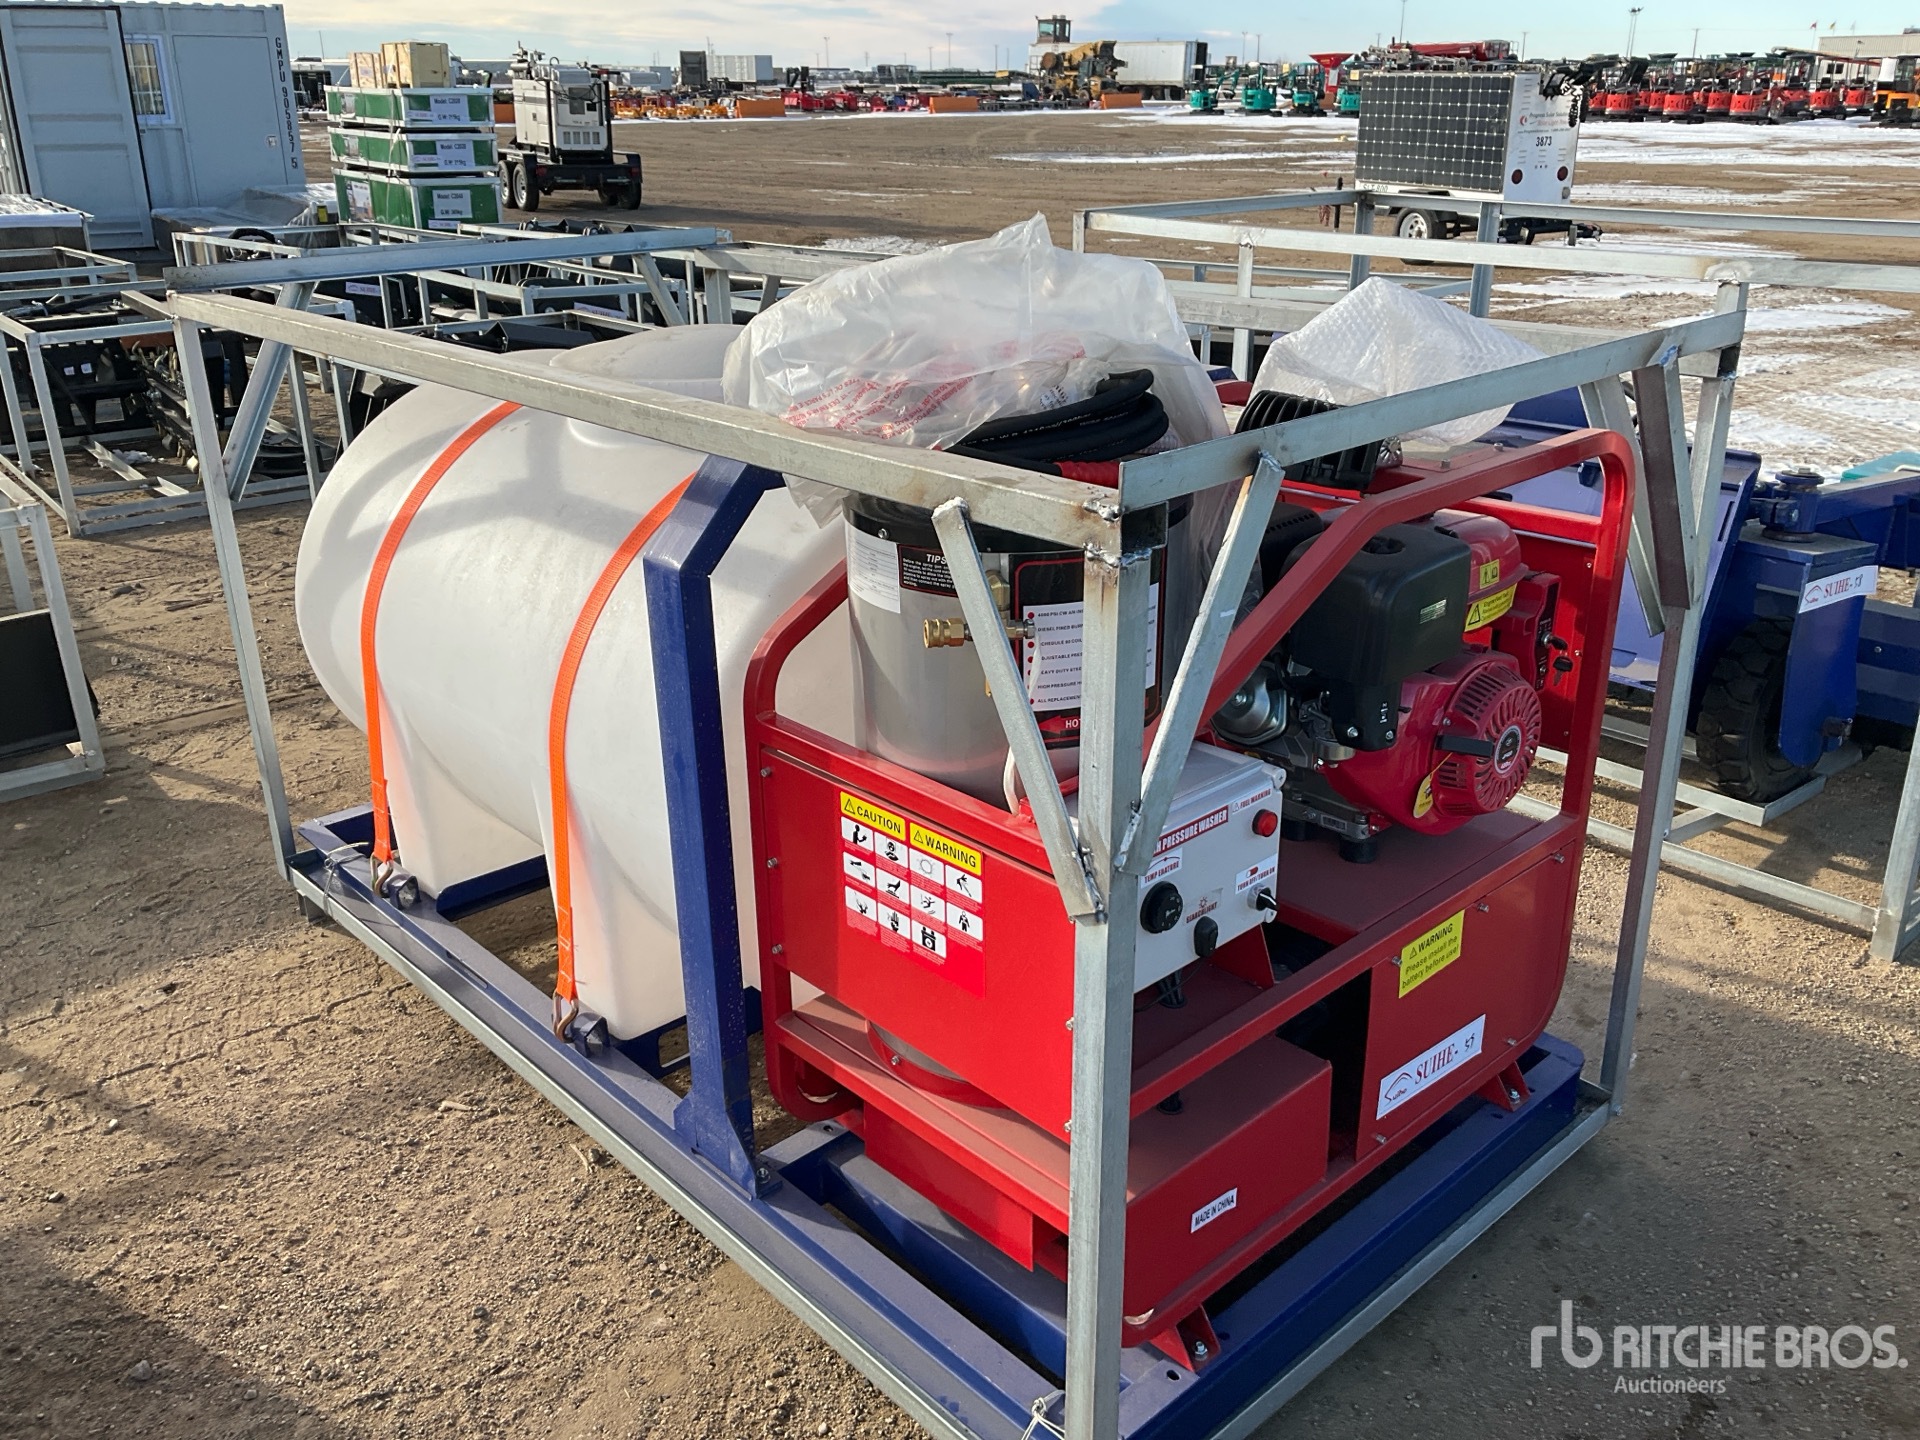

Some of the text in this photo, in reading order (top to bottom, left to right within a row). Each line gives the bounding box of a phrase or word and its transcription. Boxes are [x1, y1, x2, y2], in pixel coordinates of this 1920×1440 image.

[275, 37, 286, 82] GMPU
[282, 86, 294, 153] 905857
[1536, 136, 1552, 146] 3873
[1240, 788, 1271, 808] FUEL WARNING
[856, 807, 901, 834] CAUTION
[1162, 824, 1198, 850] PRESSURE
[1199, 810, 1227, 832] WASHER
[925, 835, 976, 867] WARNING
[1238, 881, 1248, 891] TURN
[1186, 902, 1217, 923] SEARCHLIGHT
[1418, 923, 1453, 952] WARNING
[1406, 936, 1458, 975] Please install the
[1402, 970, 1423, 989] battery
[1425, 955, 1445, 973] before
[1195, 1195, 1234, 1226] MADE IN CHINA
